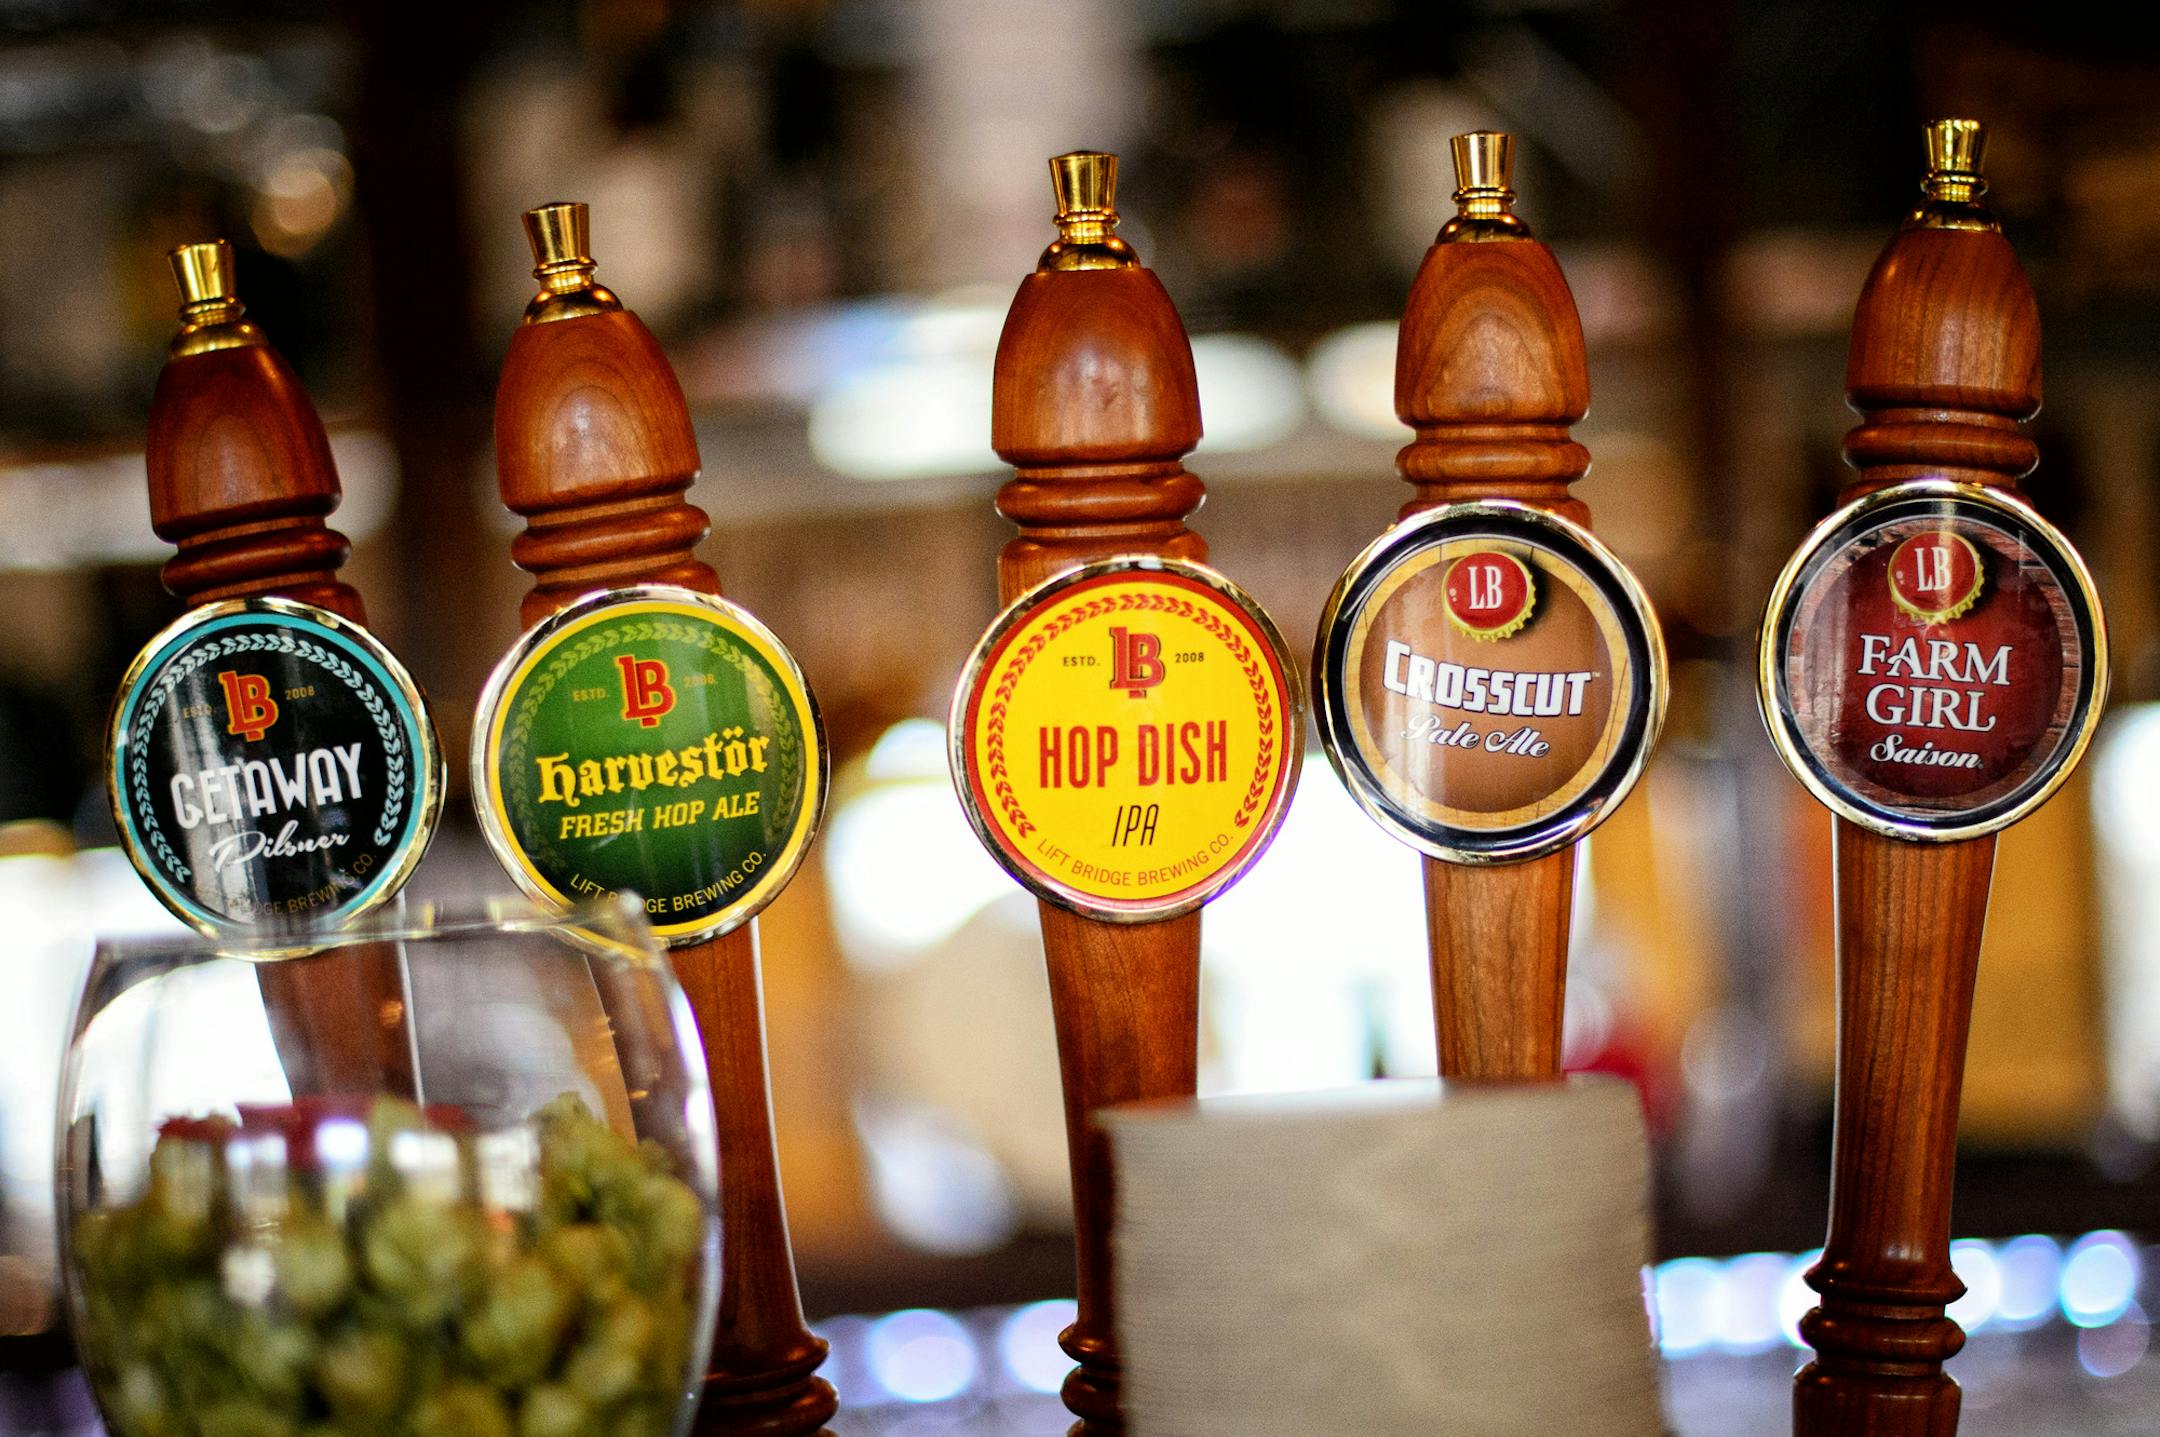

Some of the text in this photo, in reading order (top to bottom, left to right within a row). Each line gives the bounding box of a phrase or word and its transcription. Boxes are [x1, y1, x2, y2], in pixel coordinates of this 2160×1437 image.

[1468, 565, 1503, 610] LB
[1914, 546, 1951, 592] LB
[1062, 655, 1100, 667] ESTD.
[1174, 651, 1205, 664] 2008
[1857, 634, 2013, 686] FARM
[285, 685, 316, 700] 2008
[1866, 683, 1996, 732] GIRL
[1039, 720, 1227, 789] HOP DISH
[1400, 714, 1550, 758] Pale Ale
[1869, 733, 1981, 769] Saison
[171, 743, 363, 829] GETAWAY
[560, 791, 761, 840] FRESH HOP ALE
[1111, 804, 1160, 847] IPA
[209, 820, 350, 872] Pilsner
[1037, 833, 1235, 886] LIFT BRIDGE BREWING CO.
[570, 851, 767, 913] LIFT BGE BREWING CO.
